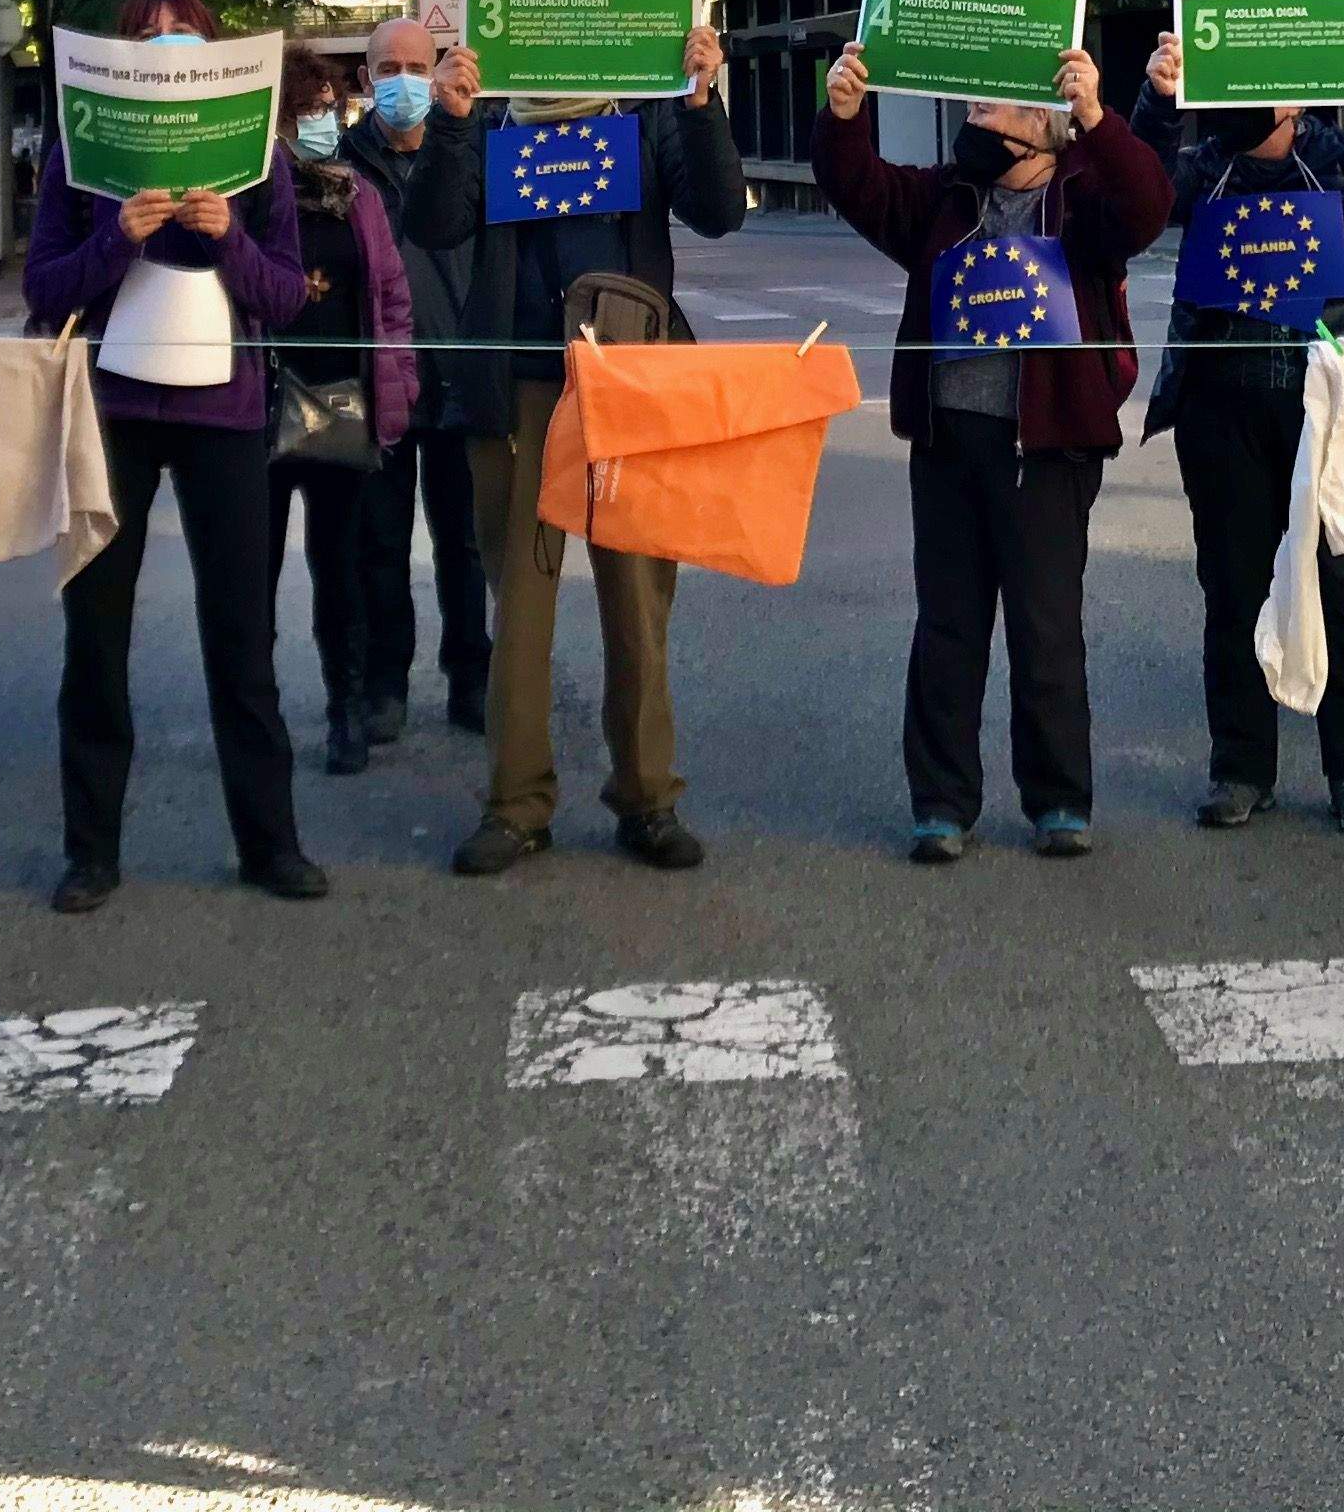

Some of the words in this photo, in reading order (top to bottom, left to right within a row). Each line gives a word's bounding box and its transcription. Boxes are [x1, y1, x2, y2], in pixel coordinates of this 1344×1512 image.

[952, 1, 1027, 17] INTERNACIONAL
[1225, 7, 1274, 19] ACOLLIDA
[1276, 6, 1308, 18] DIGNA
[1193, 9, 1219, 50] 5
[69, 57, 110, 79] Demanem
[133, 70, 170, 85] Europa
[173, 69, 187, 83] de
[190, 65, 219, 83] Drets
[72, 101, 94, 142] 2
[97, 106, 149, 125] SALVAMENT
[153, 111, 198, 125] MARÍTIM
[535, 160, 591, 176] LETÒNIA
[1240, 240, 1296, 255] IRLANDA
